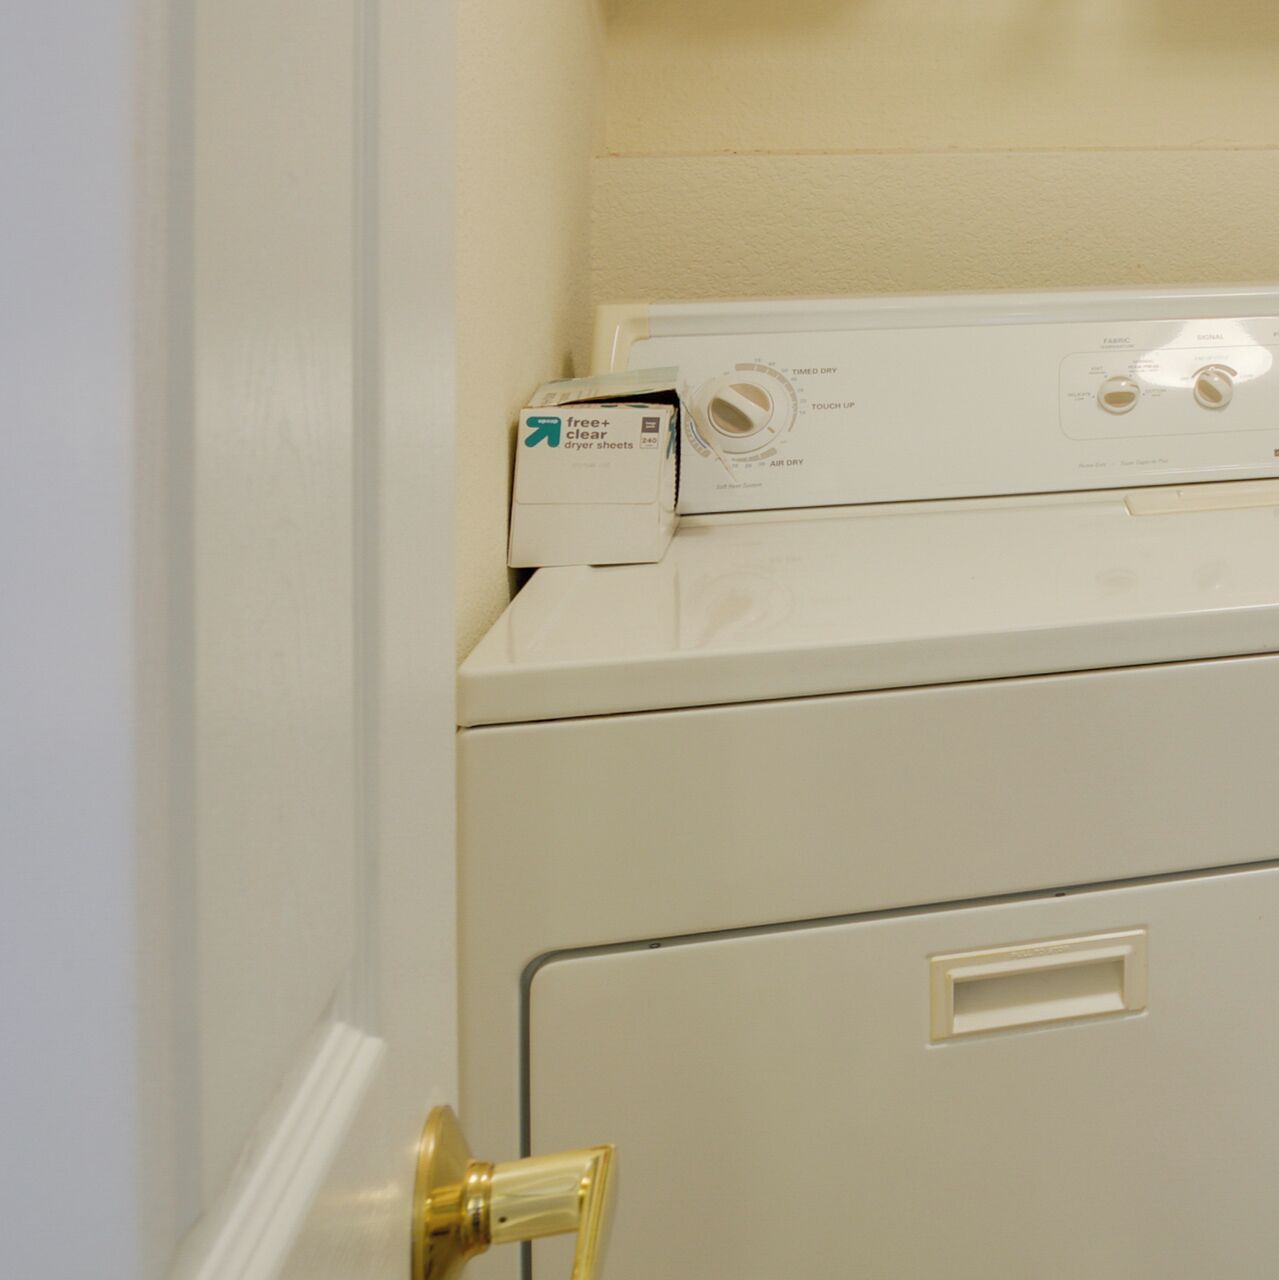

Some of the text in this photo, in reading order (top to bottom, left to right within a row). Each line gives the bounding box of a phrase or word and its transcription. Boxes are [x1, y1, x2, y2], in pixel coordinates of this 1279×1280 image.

[792, 367, 837, 376] TIMED DRY
[567, 416, 610, 428] free+
[566, 429, 608, 440] clear
[564, 440, 634, 451] dryer sheets
[786, 459, 804, 467] DRY
